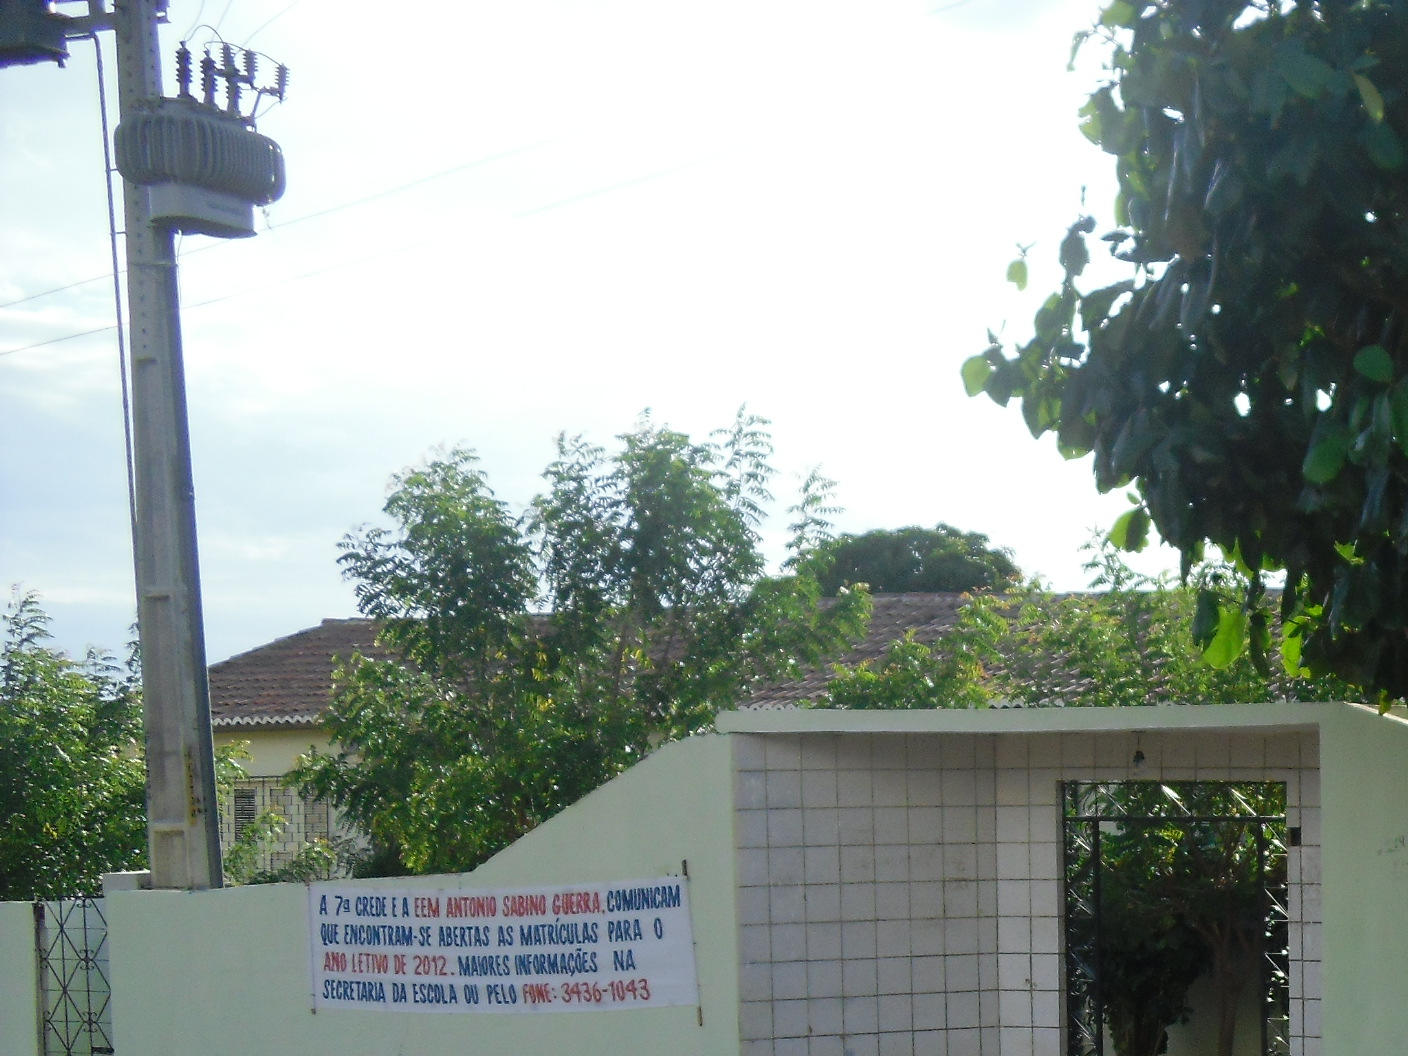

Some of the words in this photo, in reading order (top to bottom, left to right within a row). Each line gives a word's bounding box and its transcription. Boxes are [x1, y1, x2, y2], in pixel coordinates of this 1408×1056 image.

[320, 895, 328, 915] A
[355, 897, 387, 917] CREDE
[392, 897, 397, 917] E
[402, 897, 409, 918] A
[414, 897, 440, 918] EEM
[446, 896, 497, 918] ANTONIO
[502, 894, 546, 917] SABINO
[607, 885, 681, 912] COMUNICAM
[321, 923, 340, 946] QUE
[344, 924, 432, 947] ENCONTRAM-SE
[439, 926, 490, 947] ABERTAS
[498, 926, 514, 947] AS
[519, 917, 599, 946] MATRÍCULAS
[608, 920, 642, 943] PARA
[653, 917, 663, 940] O
[324, 952, 347, 973] ANO
[351, 953, 389, 974] LETIVO
[394, 955, 407, 975] DE
[413, 956, 455, 976] 2012.
[458, 955, 510, 977] MAIORES
[514, 948, 598, 977] INFORMAÇÕES
[613, 949, 636, 972] NA
[322, 980, 386, 1003] SECRETARIA
[392, 983, 407, 1003] DA
[412, 983, 458, 1004] ESCOLA
[463, 984, 479, 1004] OU
[486, 984, 517, 1004] PELO
[522, 983, 558, 1004] FONE:
[560, 979, 651, 1003] 3436-1043
